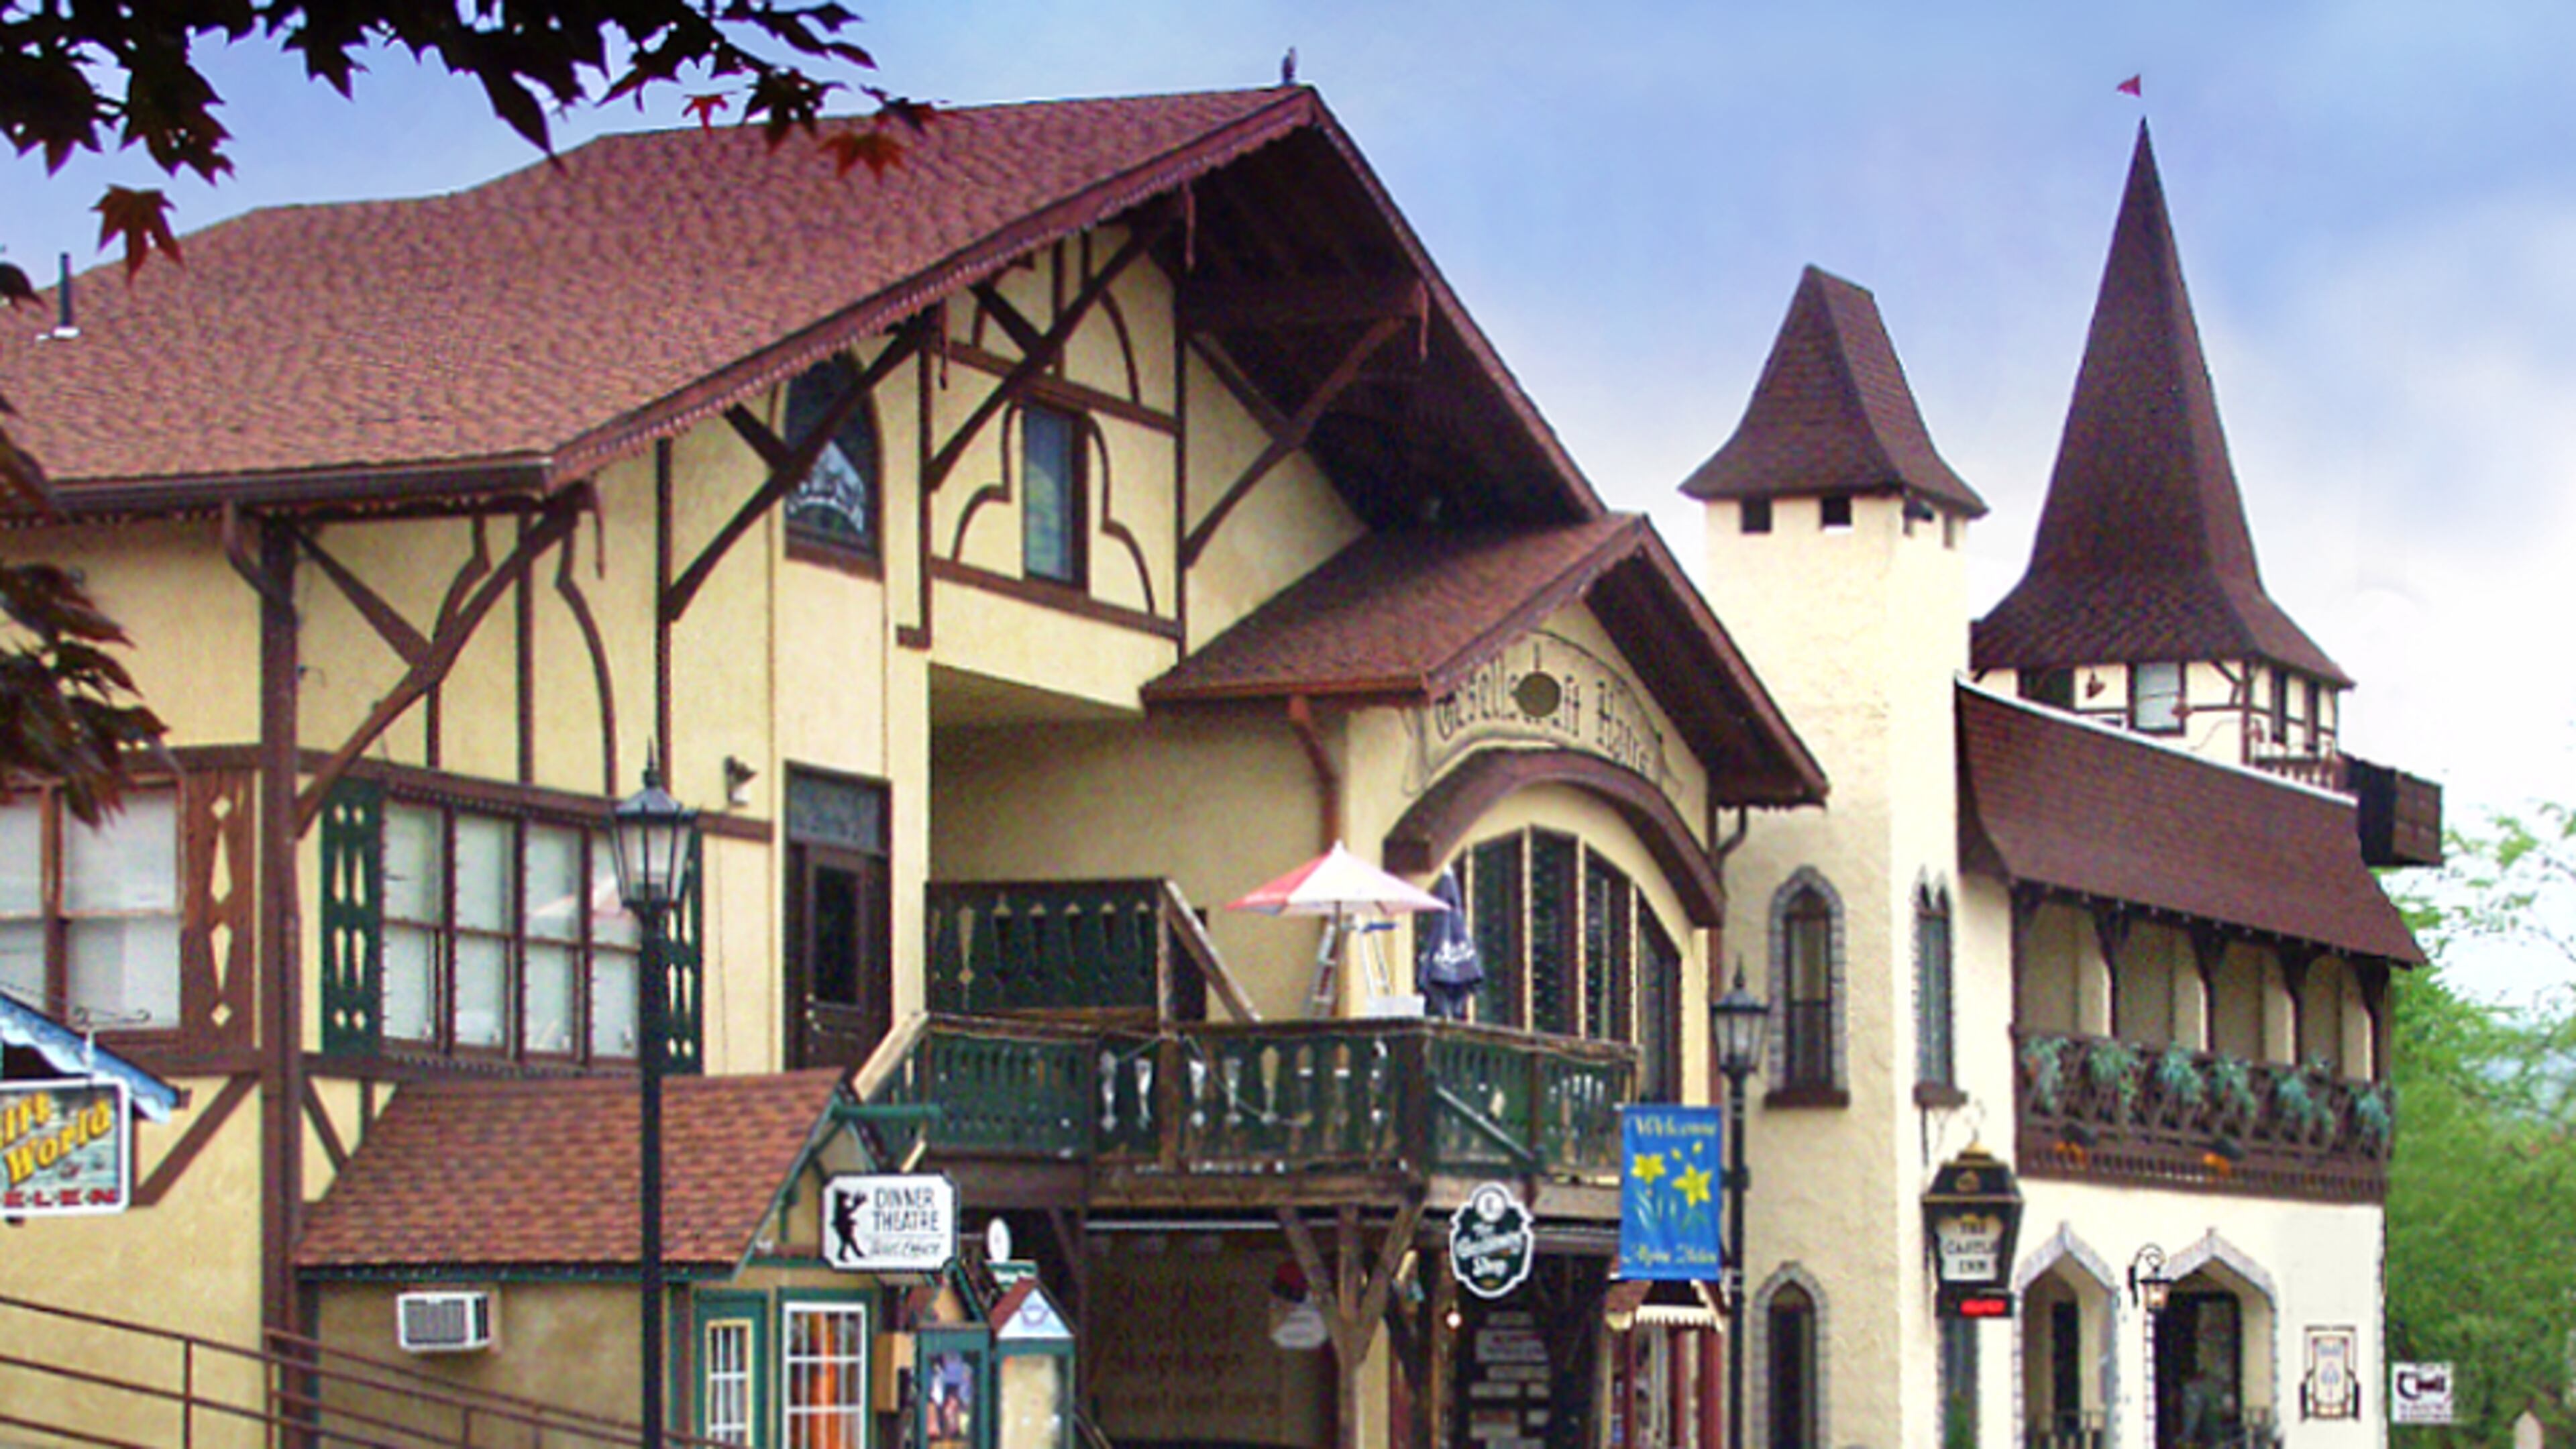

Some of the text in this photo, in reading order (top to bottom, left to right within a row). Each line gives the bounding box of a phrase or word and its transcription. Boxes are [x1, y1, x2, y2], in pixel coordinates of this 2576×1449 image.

[0, 1090, 51, 1150] ift
[1633, 1115, 1717, 1137] Welcome
[5, 1097, 113, 1186] World
[875, 1187, 935, 1208] DINNER
[873, 1210, 940, 1232] THEATRE
[1959, 1258, 1987, 1273] INN
